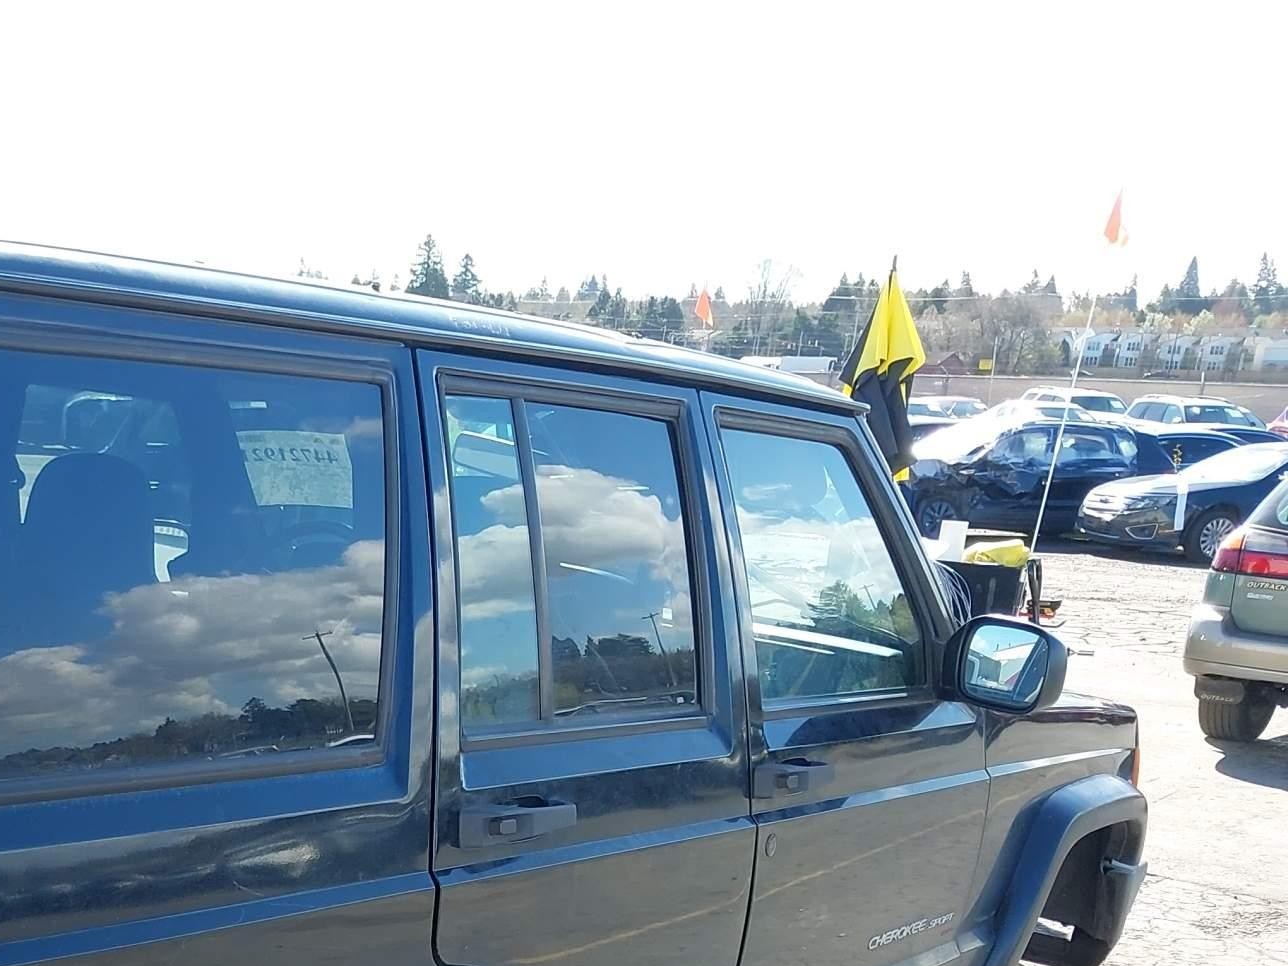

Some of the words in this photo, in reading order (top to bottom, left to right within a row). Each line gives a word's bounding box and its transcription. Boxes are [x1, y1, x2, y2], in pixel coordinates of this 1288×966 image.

[1246, 581, 1287, 591] OUTBACK
[868, 918, 928, 950] CHEROKEE
[927, 912, 955, 929] SPORT
